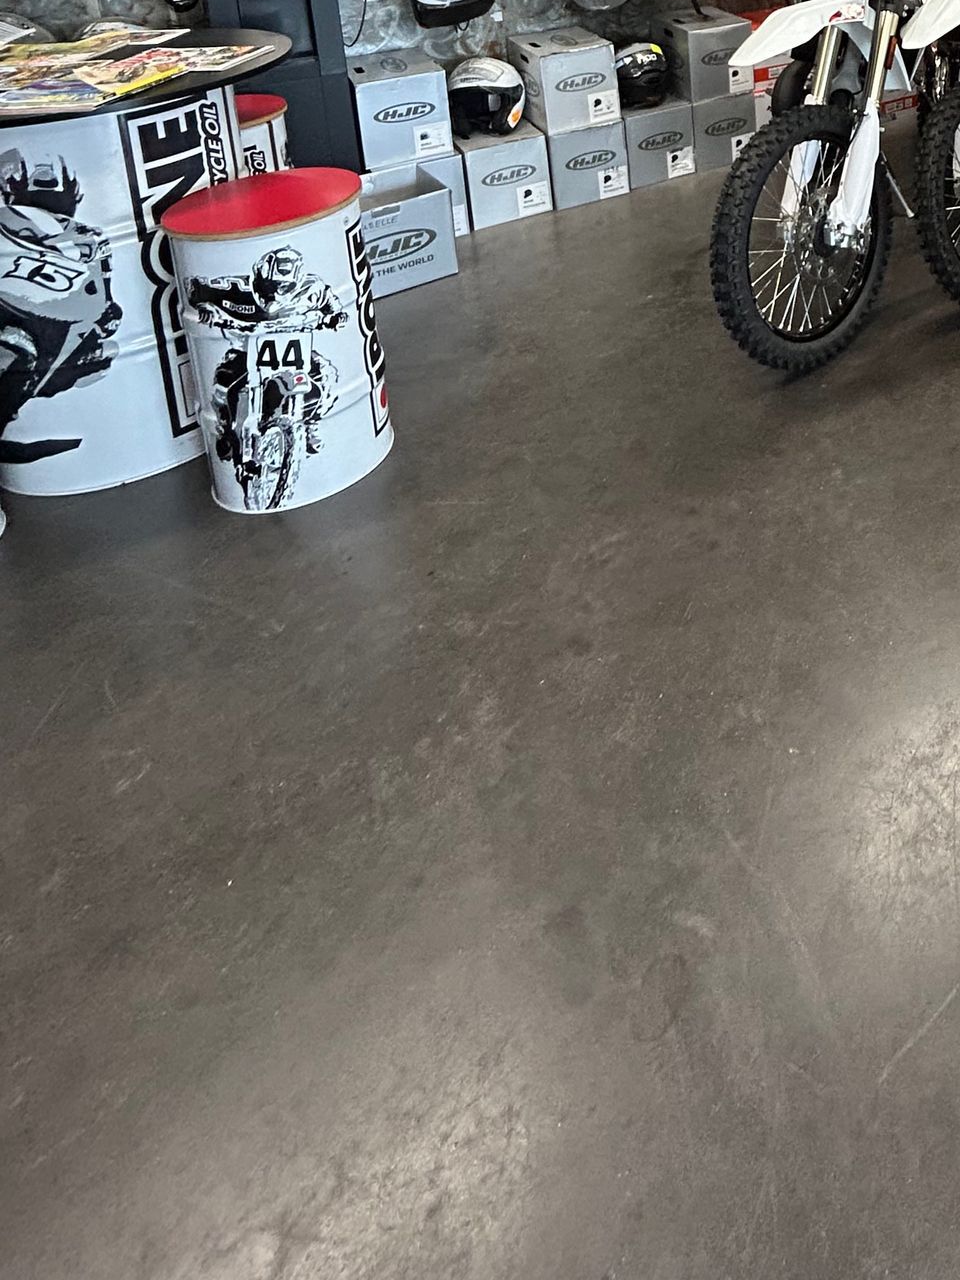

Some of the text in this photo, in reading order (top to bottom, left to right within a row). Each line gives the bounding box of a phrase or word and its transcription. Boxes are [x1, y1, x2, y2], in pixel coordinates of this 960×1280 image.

[563, 74, 600, 89] HJC
[382, 103, 428, 122] HJC
[203, 105, 227, 188] YCLE OIL
[572, 152, 610, 168] HJC
[489, 166, 530, 183] HJC
[364, 230, 425, 260] HJC
[376, 253, 434, 278] THE WORLD
[257, 338, 305, 371] 44
